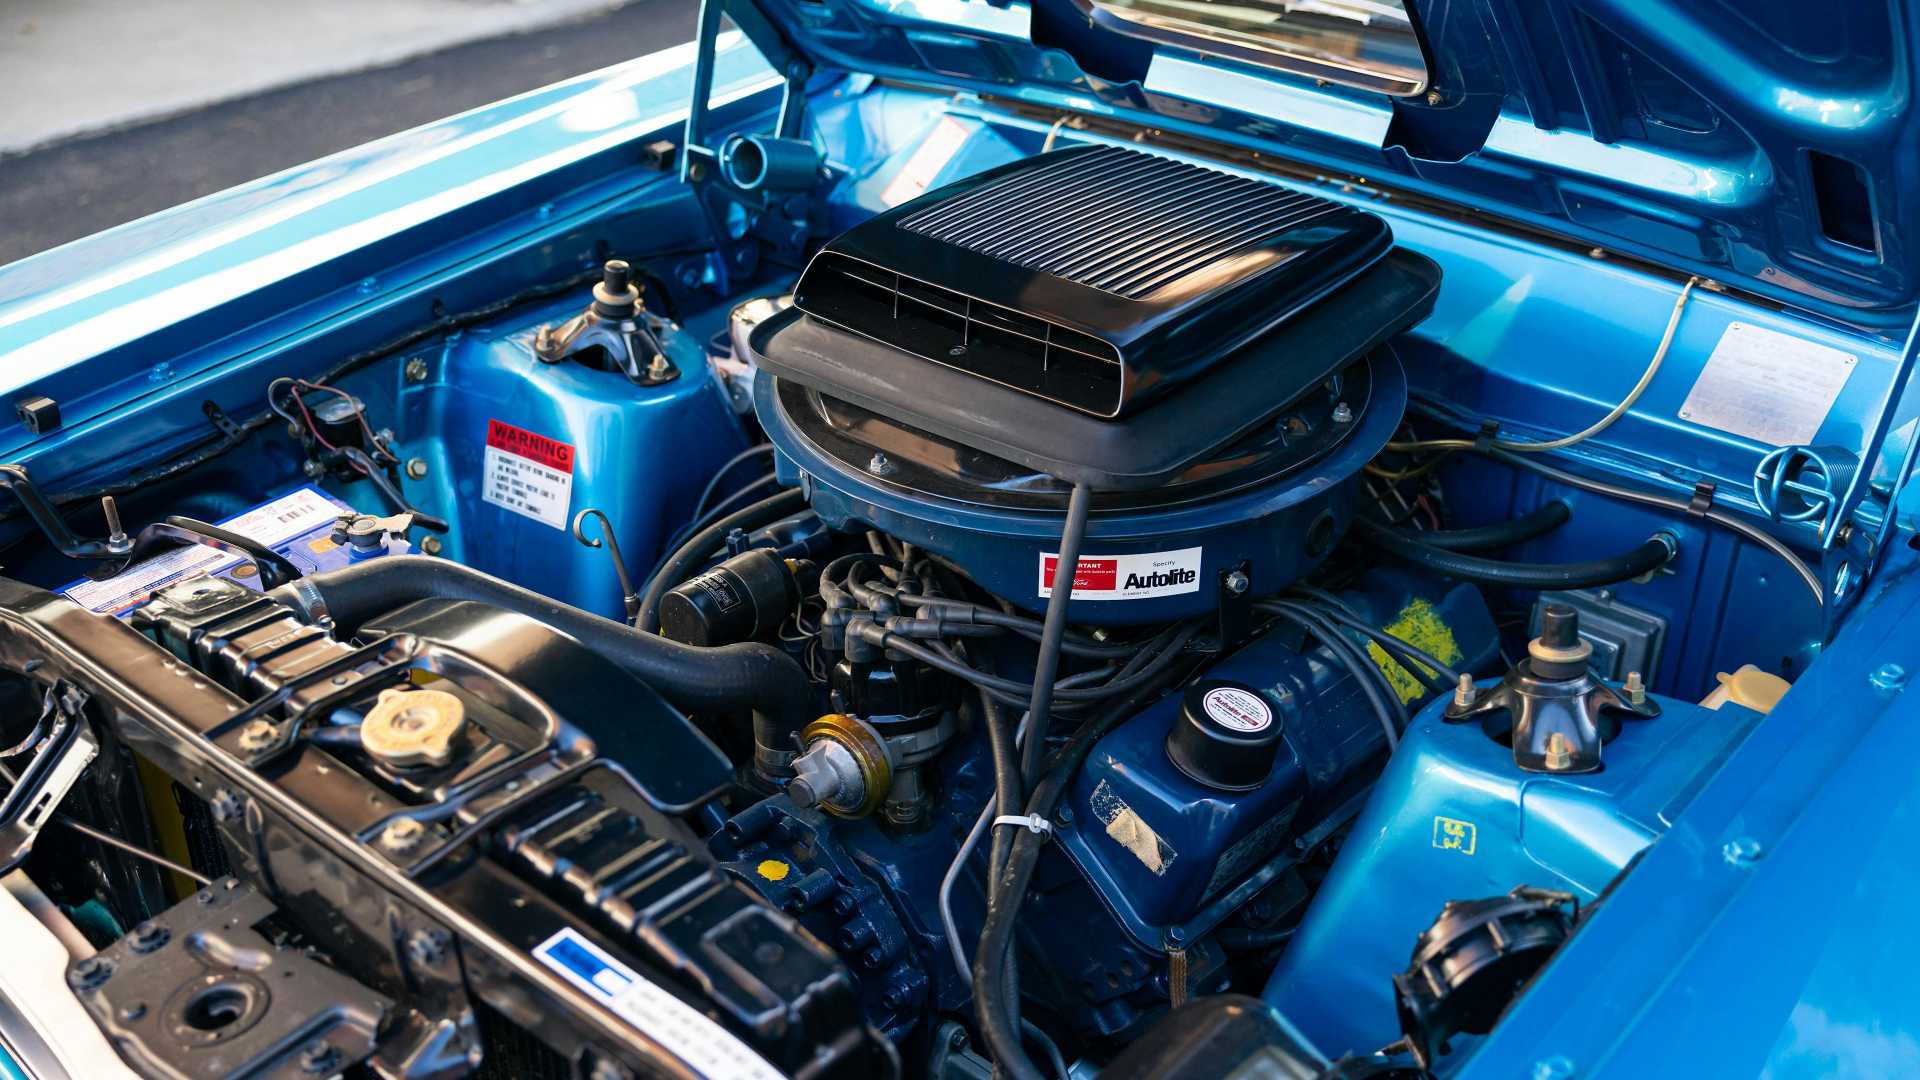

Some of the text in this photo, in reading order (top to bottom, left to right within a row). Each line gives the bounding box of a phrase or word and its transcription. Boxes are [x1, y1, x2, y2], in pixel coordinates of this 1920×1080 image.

[494, 424, 568, 461] WARNING
[1152, 560, 1176, 568] Specify
[1124, 567, 1196, 590] Autolite
